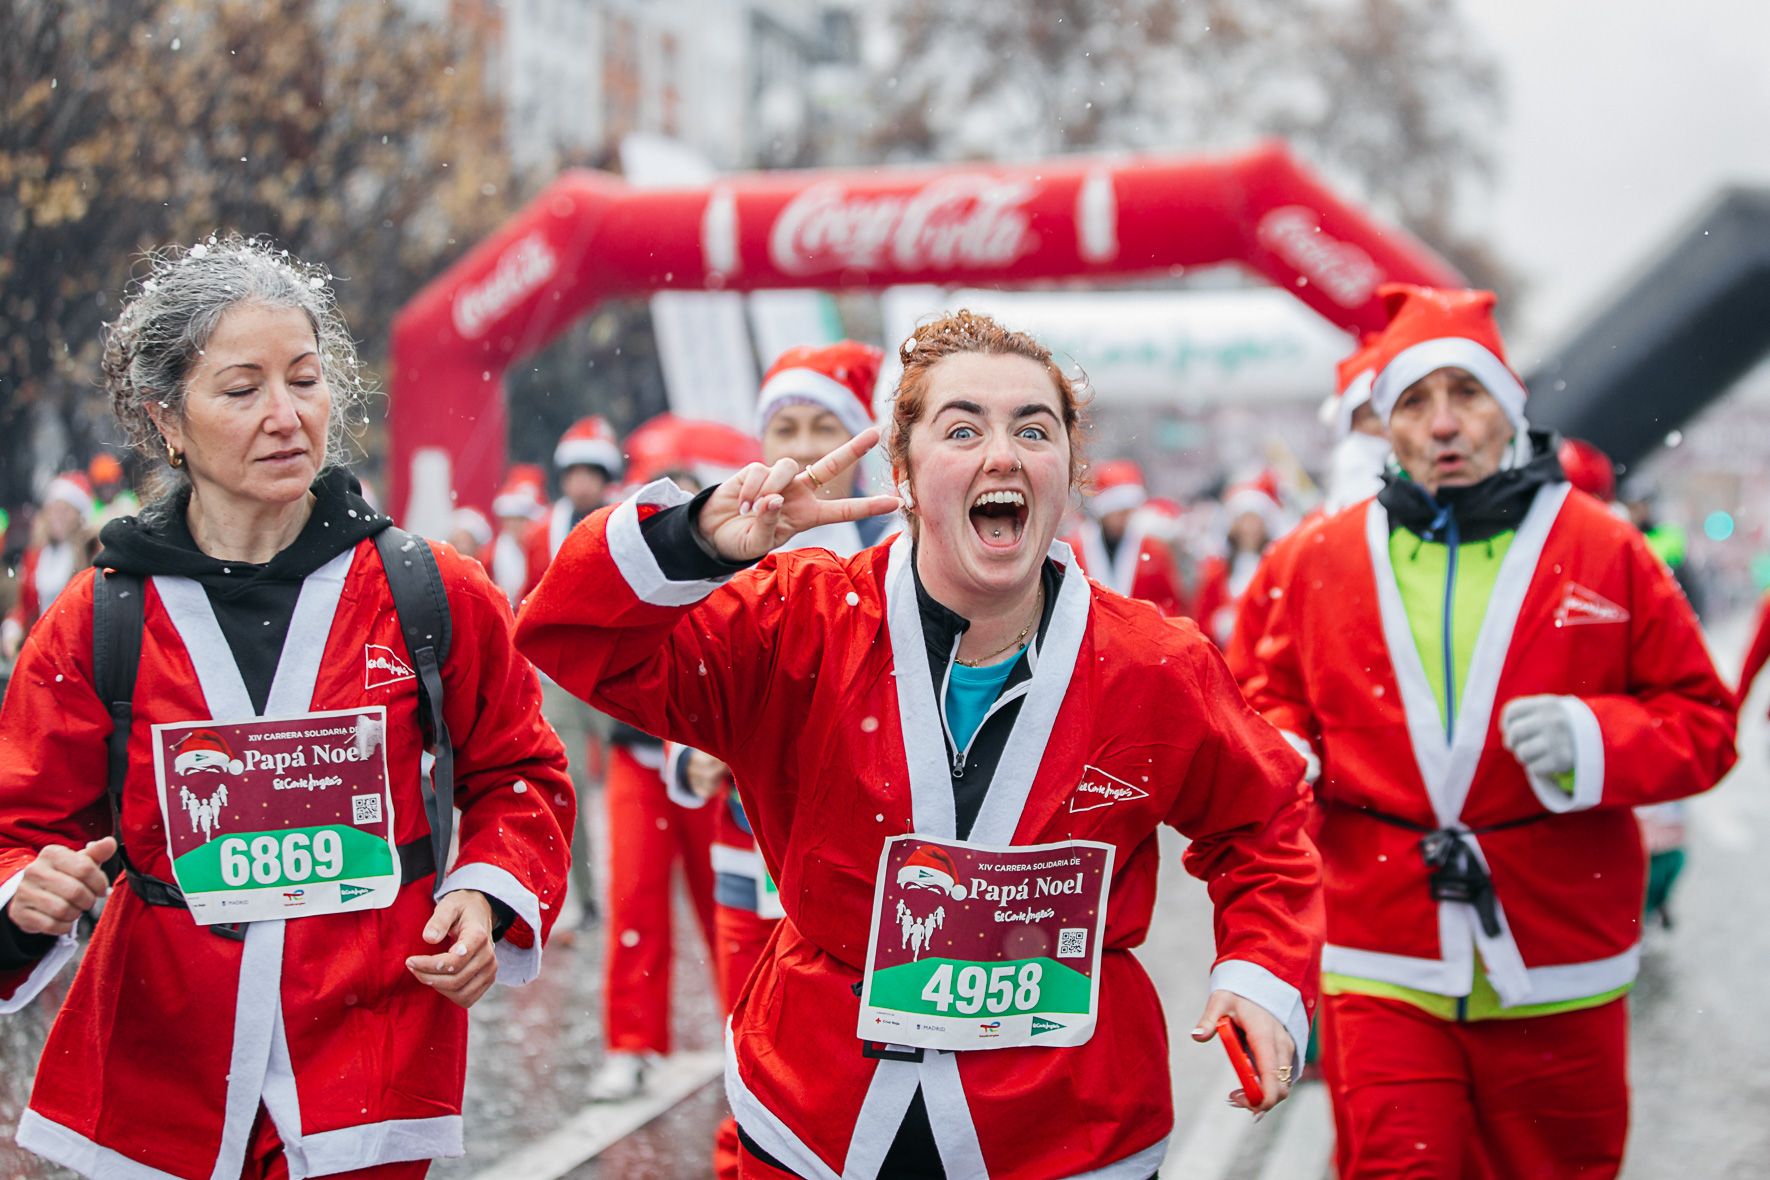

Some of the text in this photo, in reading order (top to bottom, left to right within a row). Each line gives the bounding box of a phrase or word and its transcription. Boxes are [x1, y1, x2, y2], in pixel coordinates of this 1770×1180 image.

[768, 176, 1042, 276] Coca-Cola
[248, 734, 262, 742] XIV
[263, 731, 303, 741] CARRERA
[304, 727, 348, 738] SOLIDARIA
[243, 745, 306, 775] Papá
[219, 829, 344, 887] 6869
[978, 858, 1081, 872] XIV CARRERA SOLIDARIA DE
[968, 872, 1084, 907] Papá Noel
[920, 962, 1043, 1015] 4958
